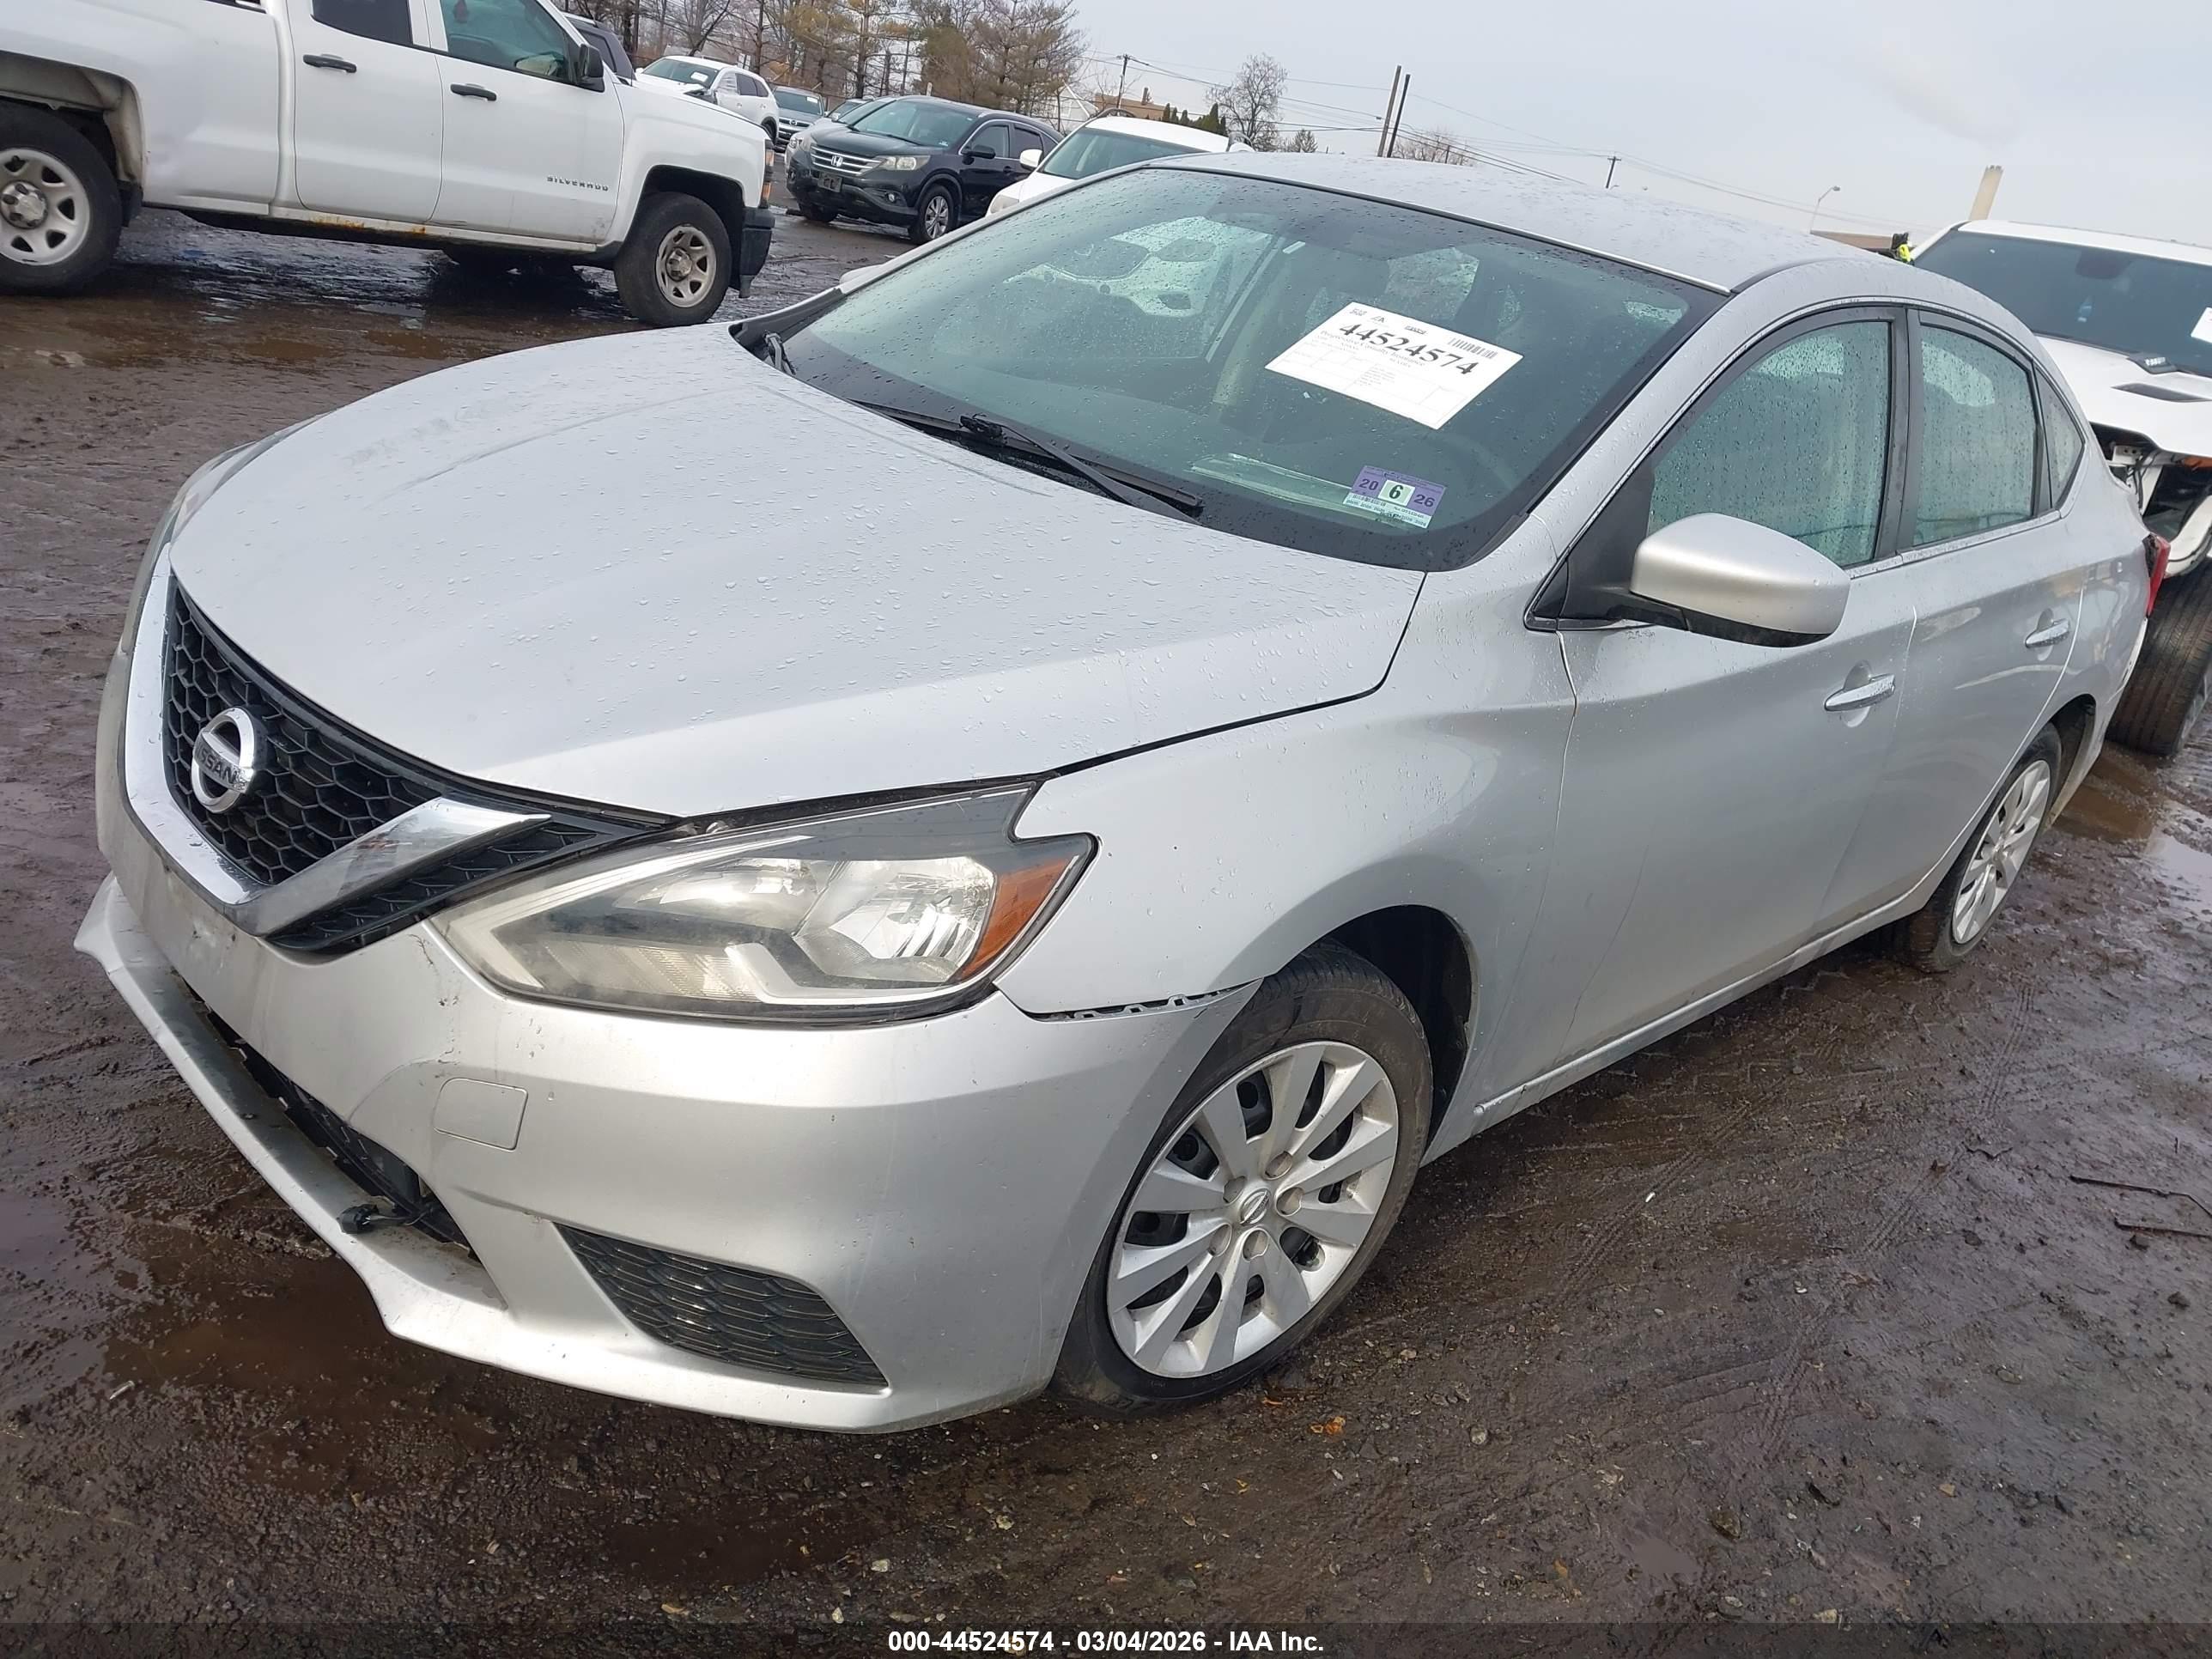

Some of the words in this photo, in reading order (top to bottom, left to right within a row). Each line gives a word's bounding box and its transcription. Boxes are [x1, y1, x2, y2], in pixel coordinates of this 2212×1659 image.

[546, 175, 610, 191] SILVERADO
[1340, 324, 1479, 374] 44524574
[1359, 478, 1379, 490] 20
[1389, 484, 1404, 499] 6
[1413, 494, 1436, 507] 26
